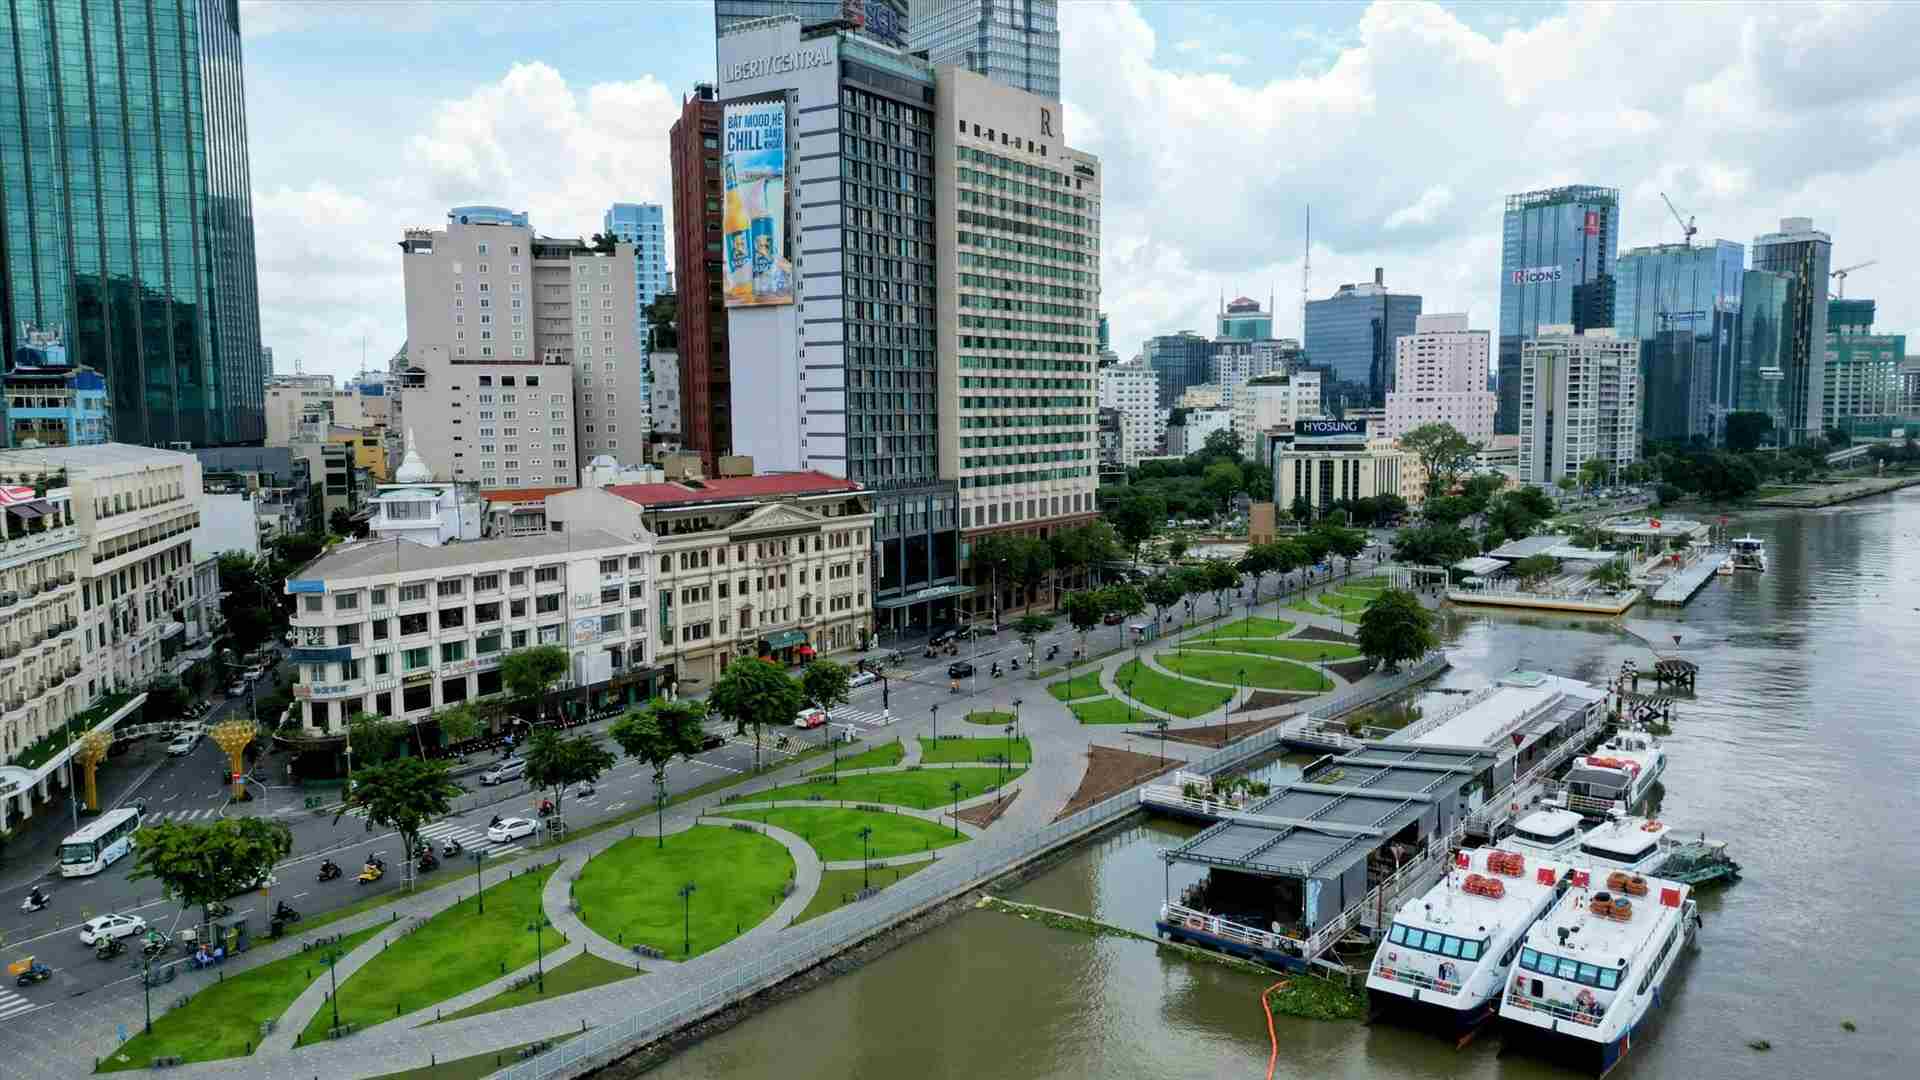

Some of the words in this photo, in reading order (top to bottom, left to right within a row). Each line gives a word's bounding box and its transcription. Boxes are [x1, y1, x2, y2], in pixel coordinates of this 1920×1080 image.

[722, 55, 773, 83] LIBERTY
[774, 47, 832, 74] CENTRAL
[745, 113, 769, 128] MOOD
[1041, 107, 1055, 137] R
[728, 130, 762, 151] CHILL
[1303, 422, 1358, 432] HYOSUNG
